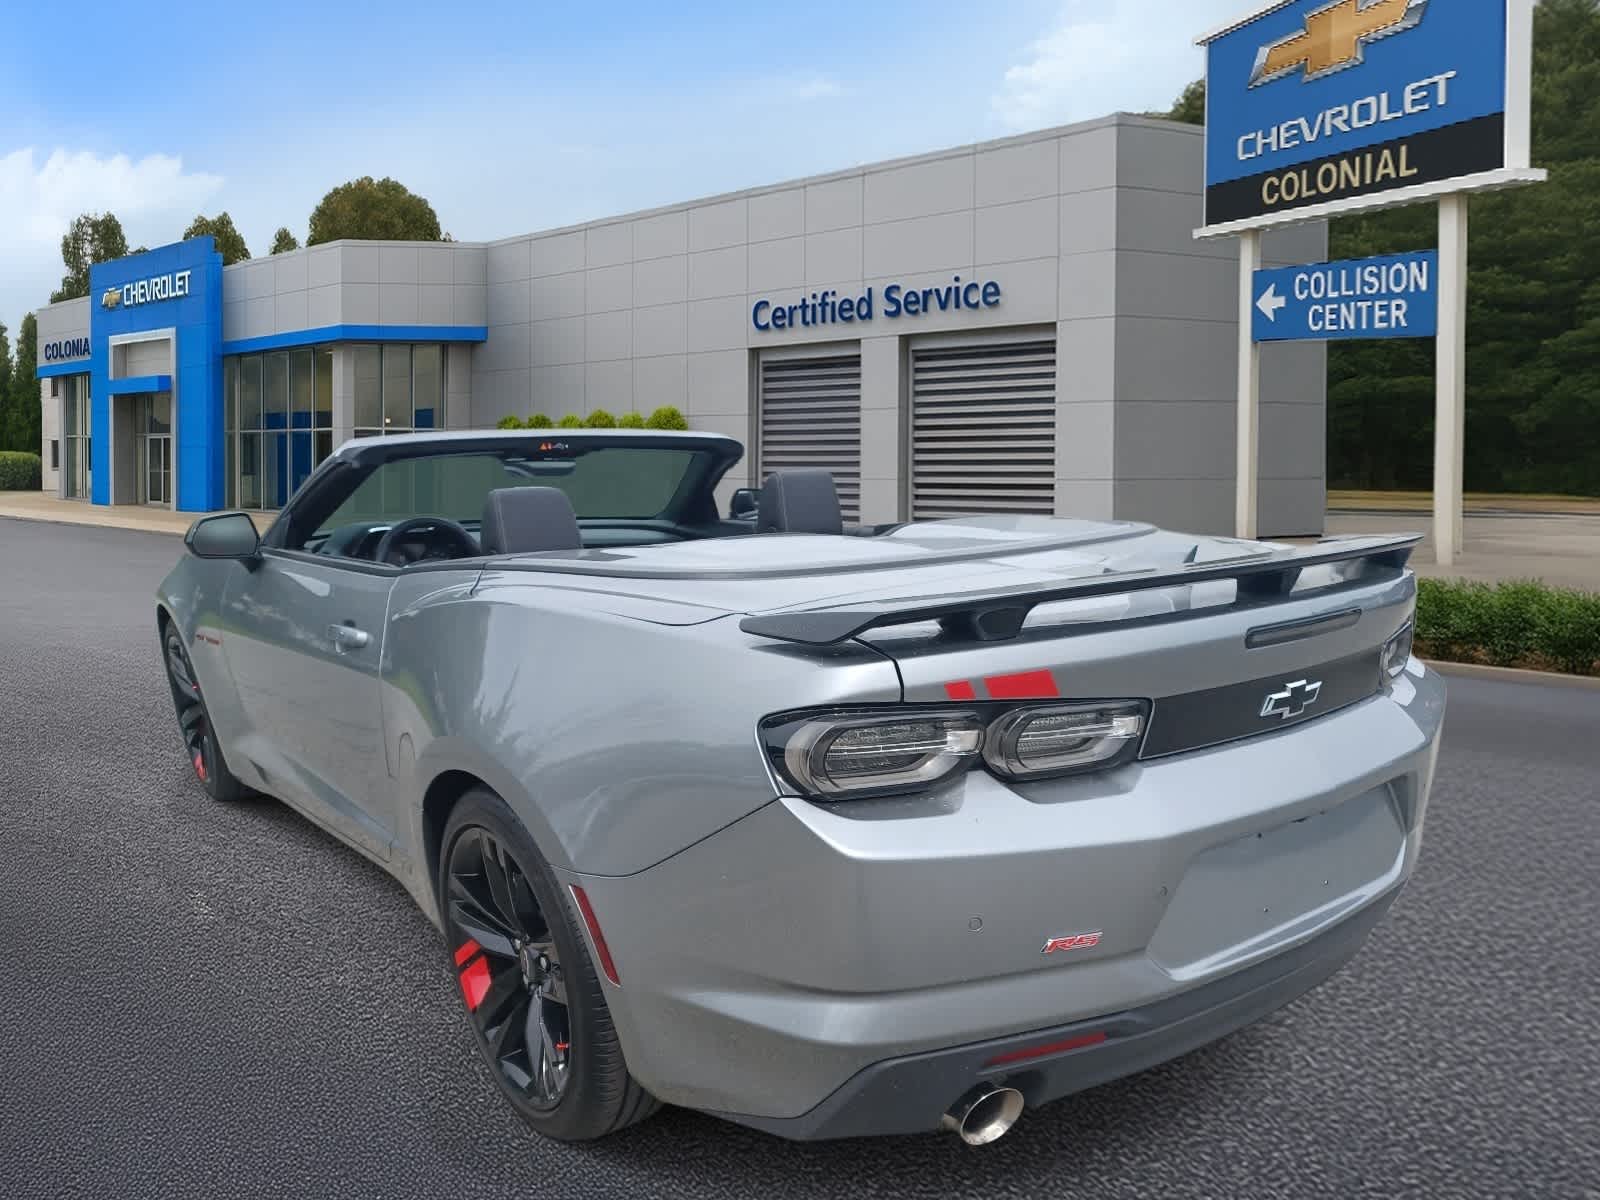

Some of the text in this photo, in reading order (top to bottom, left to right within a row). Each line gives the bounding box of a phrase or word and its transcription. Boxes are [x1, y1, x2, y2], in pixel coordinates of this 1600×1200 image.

[1237, 70, 1457, 160] CHEVROLET
[1261, 145, 1418, 205] COLONIAL
[123, 270, 191, 306] CHEVROLET
[1294, 260, 1429, 300] COLLISION
[752, 275, 1001, 331] Certified Service
[1308, 299, 1408, 332] CENTER
[44, 337, 91, 361] COLONIA
[1041, 931, 1103, 954] RS
